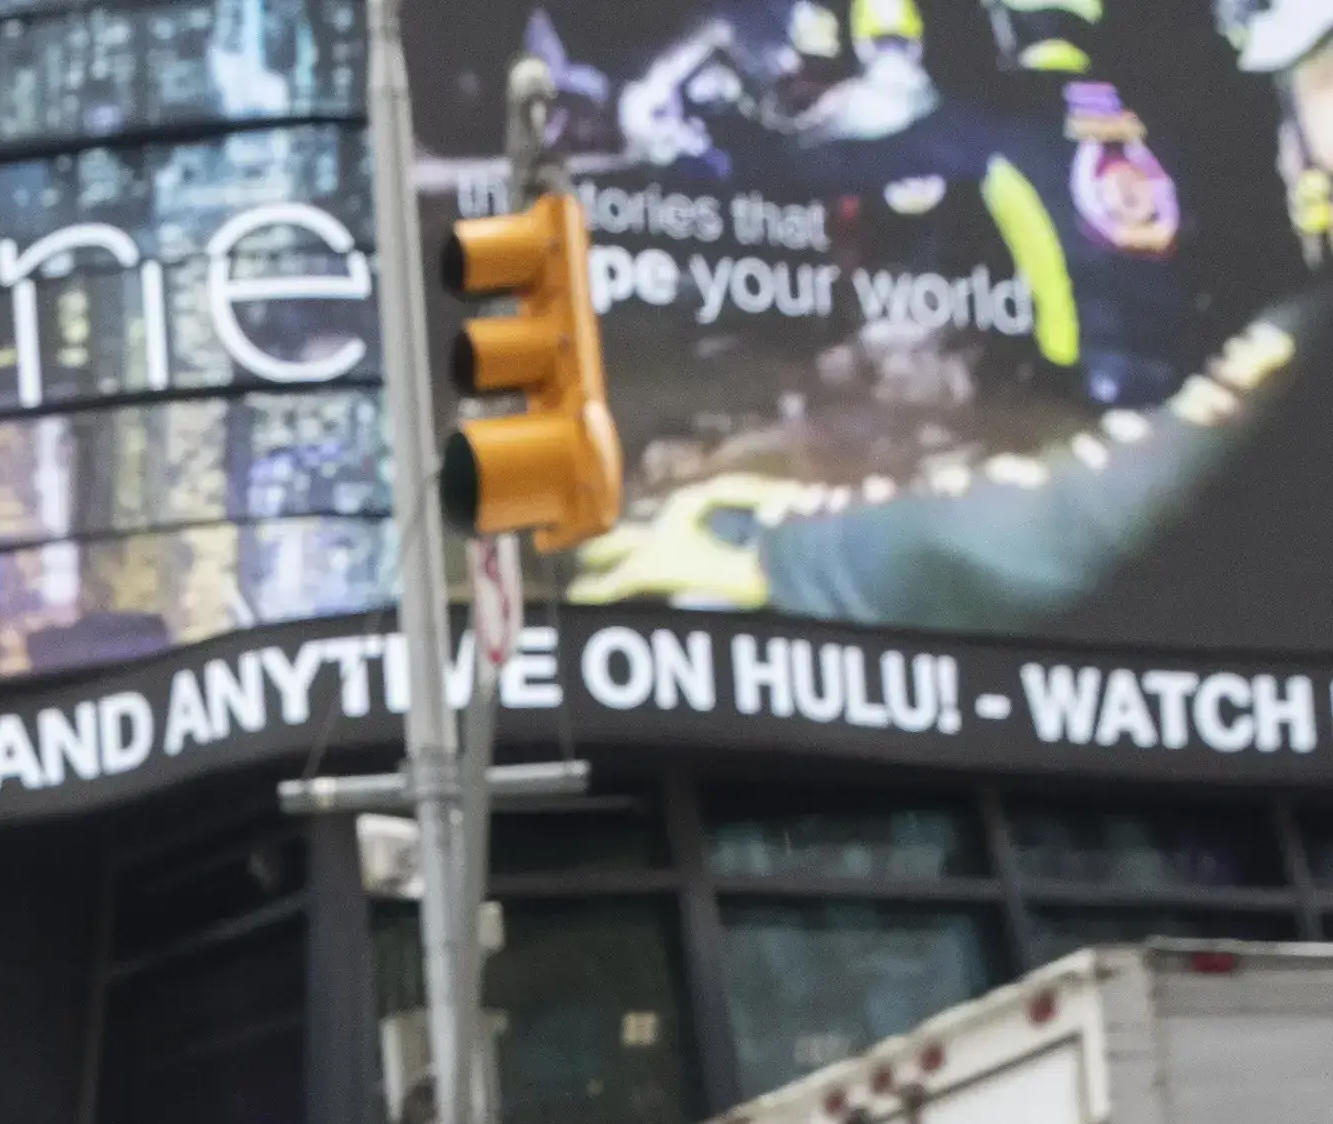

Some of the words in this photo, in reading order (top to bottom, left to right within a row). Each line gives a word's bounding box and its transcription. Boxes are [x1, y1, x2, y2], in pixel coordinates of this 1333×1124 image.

[581, 179, 724, 243] tories
[730, 186, 830, 252] that
[690, 253, 840, 324] your
[853, 264, 1036, 336] world
[580, 625, 717, 712] ON
[733, 633, 963, 735] HULU!
[1021, 661, 1318, 756] WATCH
